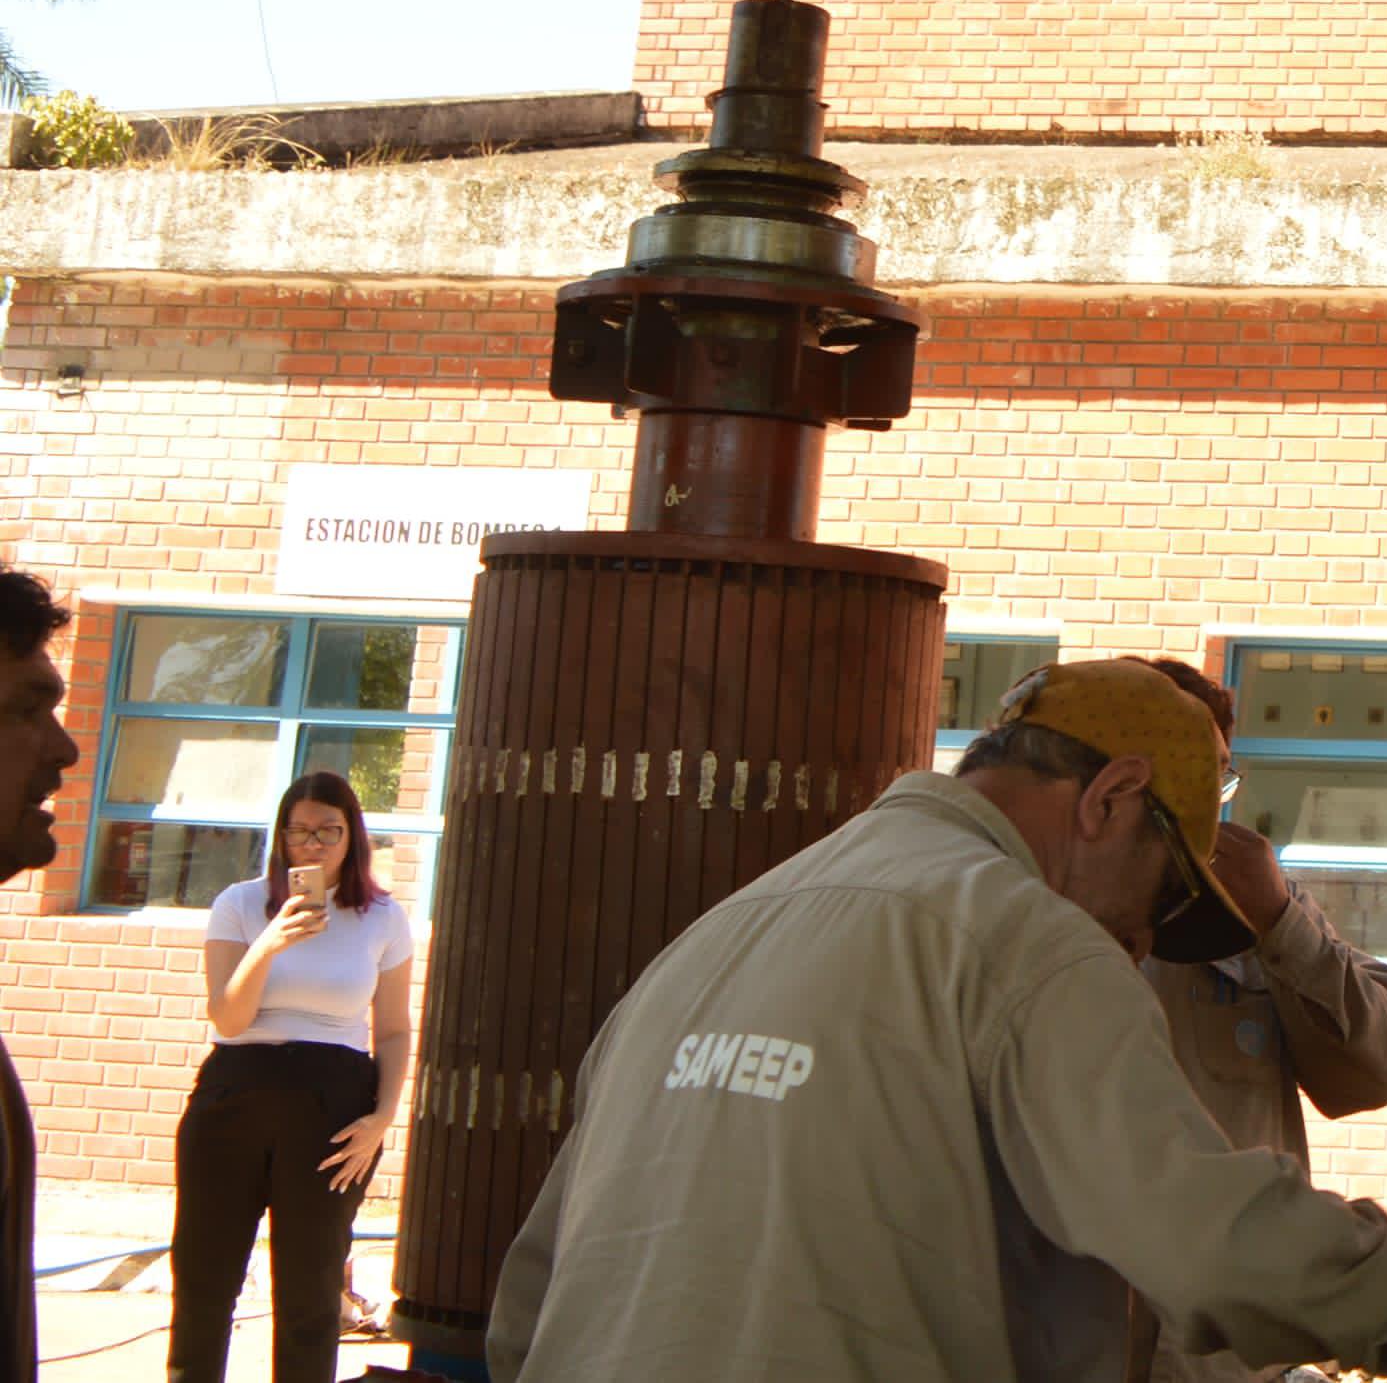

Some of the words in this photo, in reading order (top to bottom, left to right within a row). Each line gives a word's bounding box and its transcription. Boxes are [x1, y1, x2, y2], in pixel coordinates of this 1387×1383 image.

[305, 518, 411, 543] ESTACION
[418, 521, 443, 544] DE
[664, 1033, 814, 1101] SAMEEP
